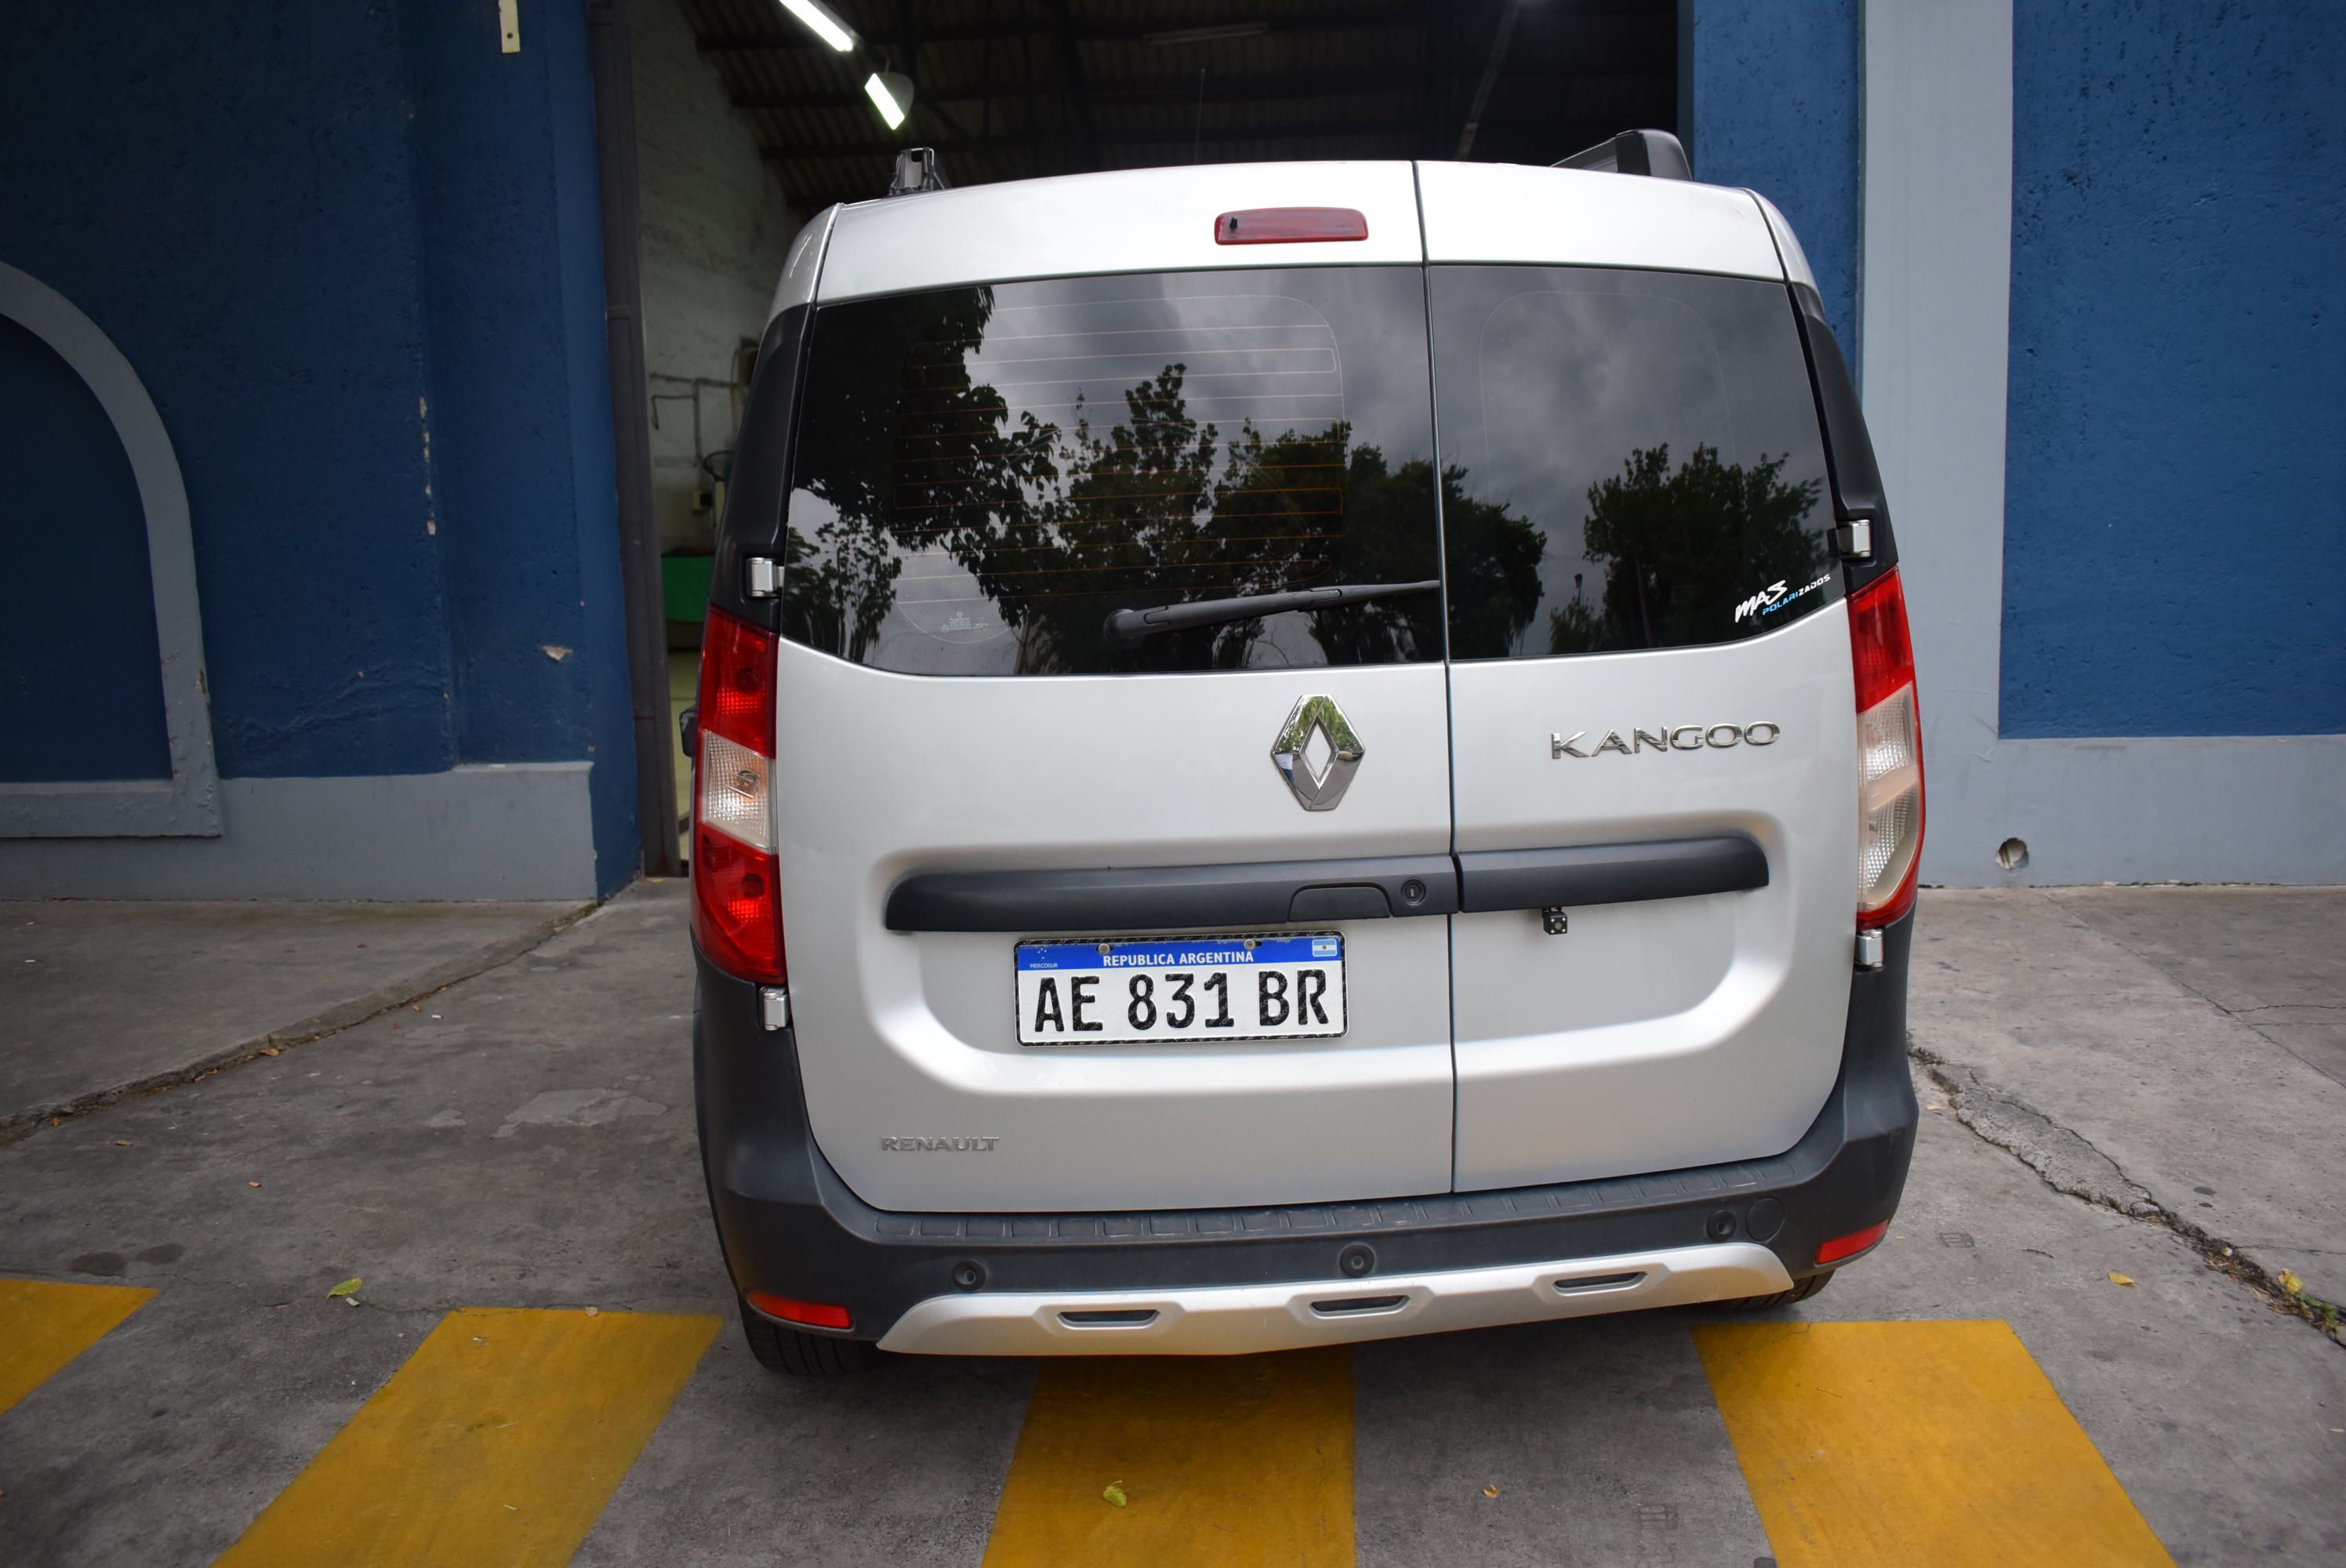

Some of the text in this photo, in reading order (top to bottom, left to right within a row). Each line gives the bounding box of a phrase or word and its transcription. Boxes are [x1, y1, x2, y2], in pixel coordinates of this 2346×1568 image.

[1734, 579, 1788, 623] MAS
[1762, 573, 1831, 615] POLARIZADOS
[1551, 720, 1781, 759] KANGOO
[1103, 951, 1254, 967] REPUBLICA ARGENTINA
[1034, 969, 1330, 1033] AE 831 BR
[881, 1136, 1000, 1152] RENAULT
